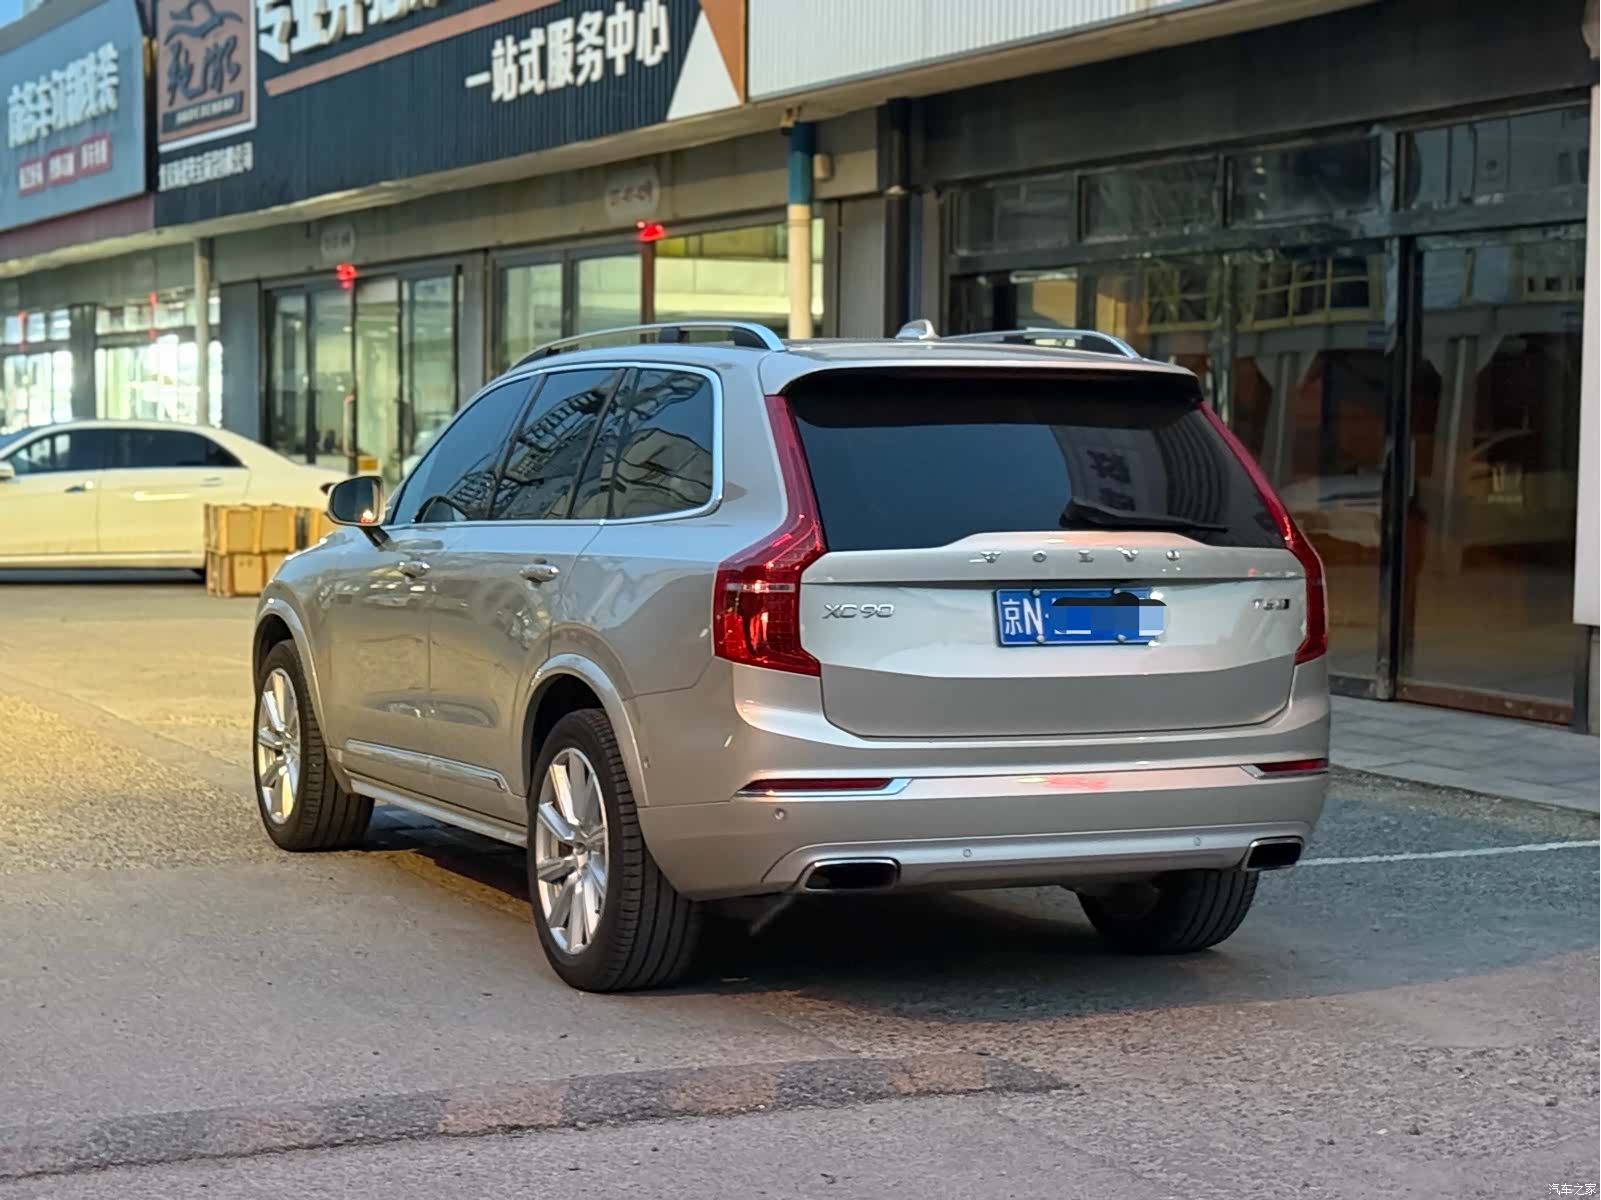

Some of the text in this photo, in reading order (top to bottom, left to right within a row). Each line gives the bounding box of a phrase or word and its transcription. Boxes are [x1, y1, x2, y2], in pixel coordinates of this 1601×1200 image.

[465, 0, 669, 102] 一站式服务中心
[980, 548, 1180, 563] VOLVO
